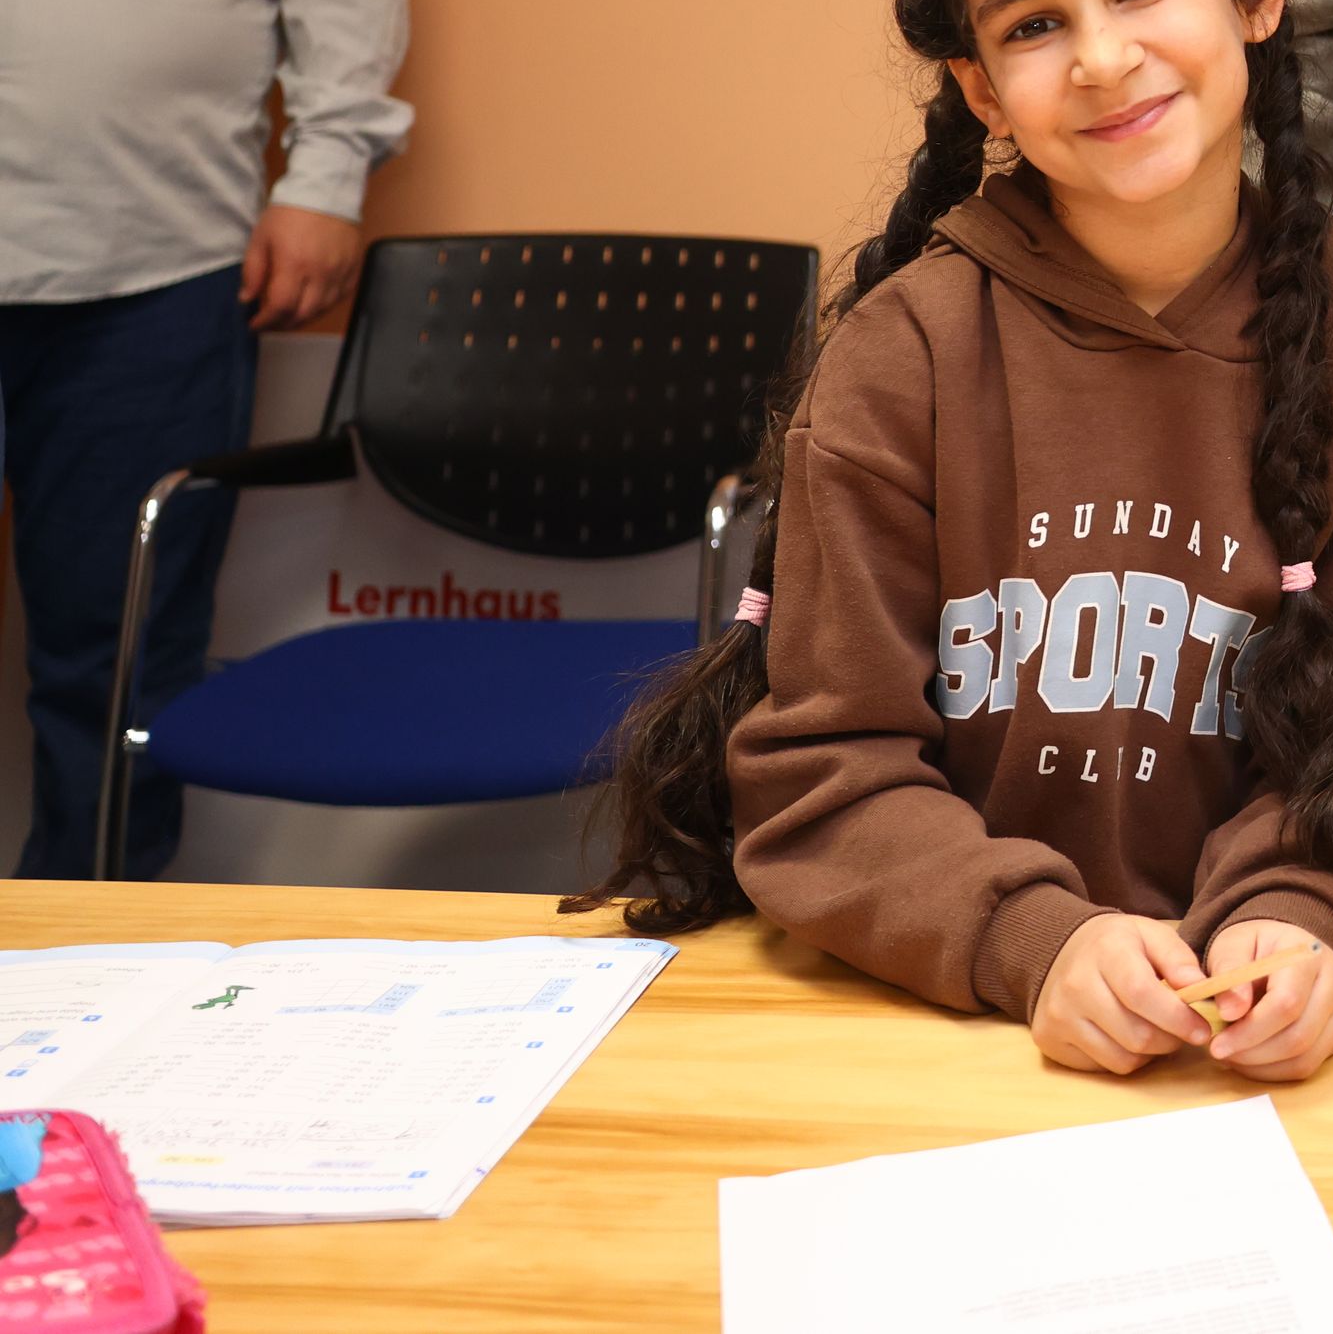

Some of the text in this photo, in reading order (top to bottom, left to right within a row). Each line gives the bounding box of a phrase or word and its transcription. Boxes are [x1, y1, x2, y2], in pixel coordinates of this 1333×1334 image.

[1028, 500, 1240, 574] SUNDAY
[327, 568, 561, 621] Lernhaus
[1037, 745, 1157, 783] CLB
